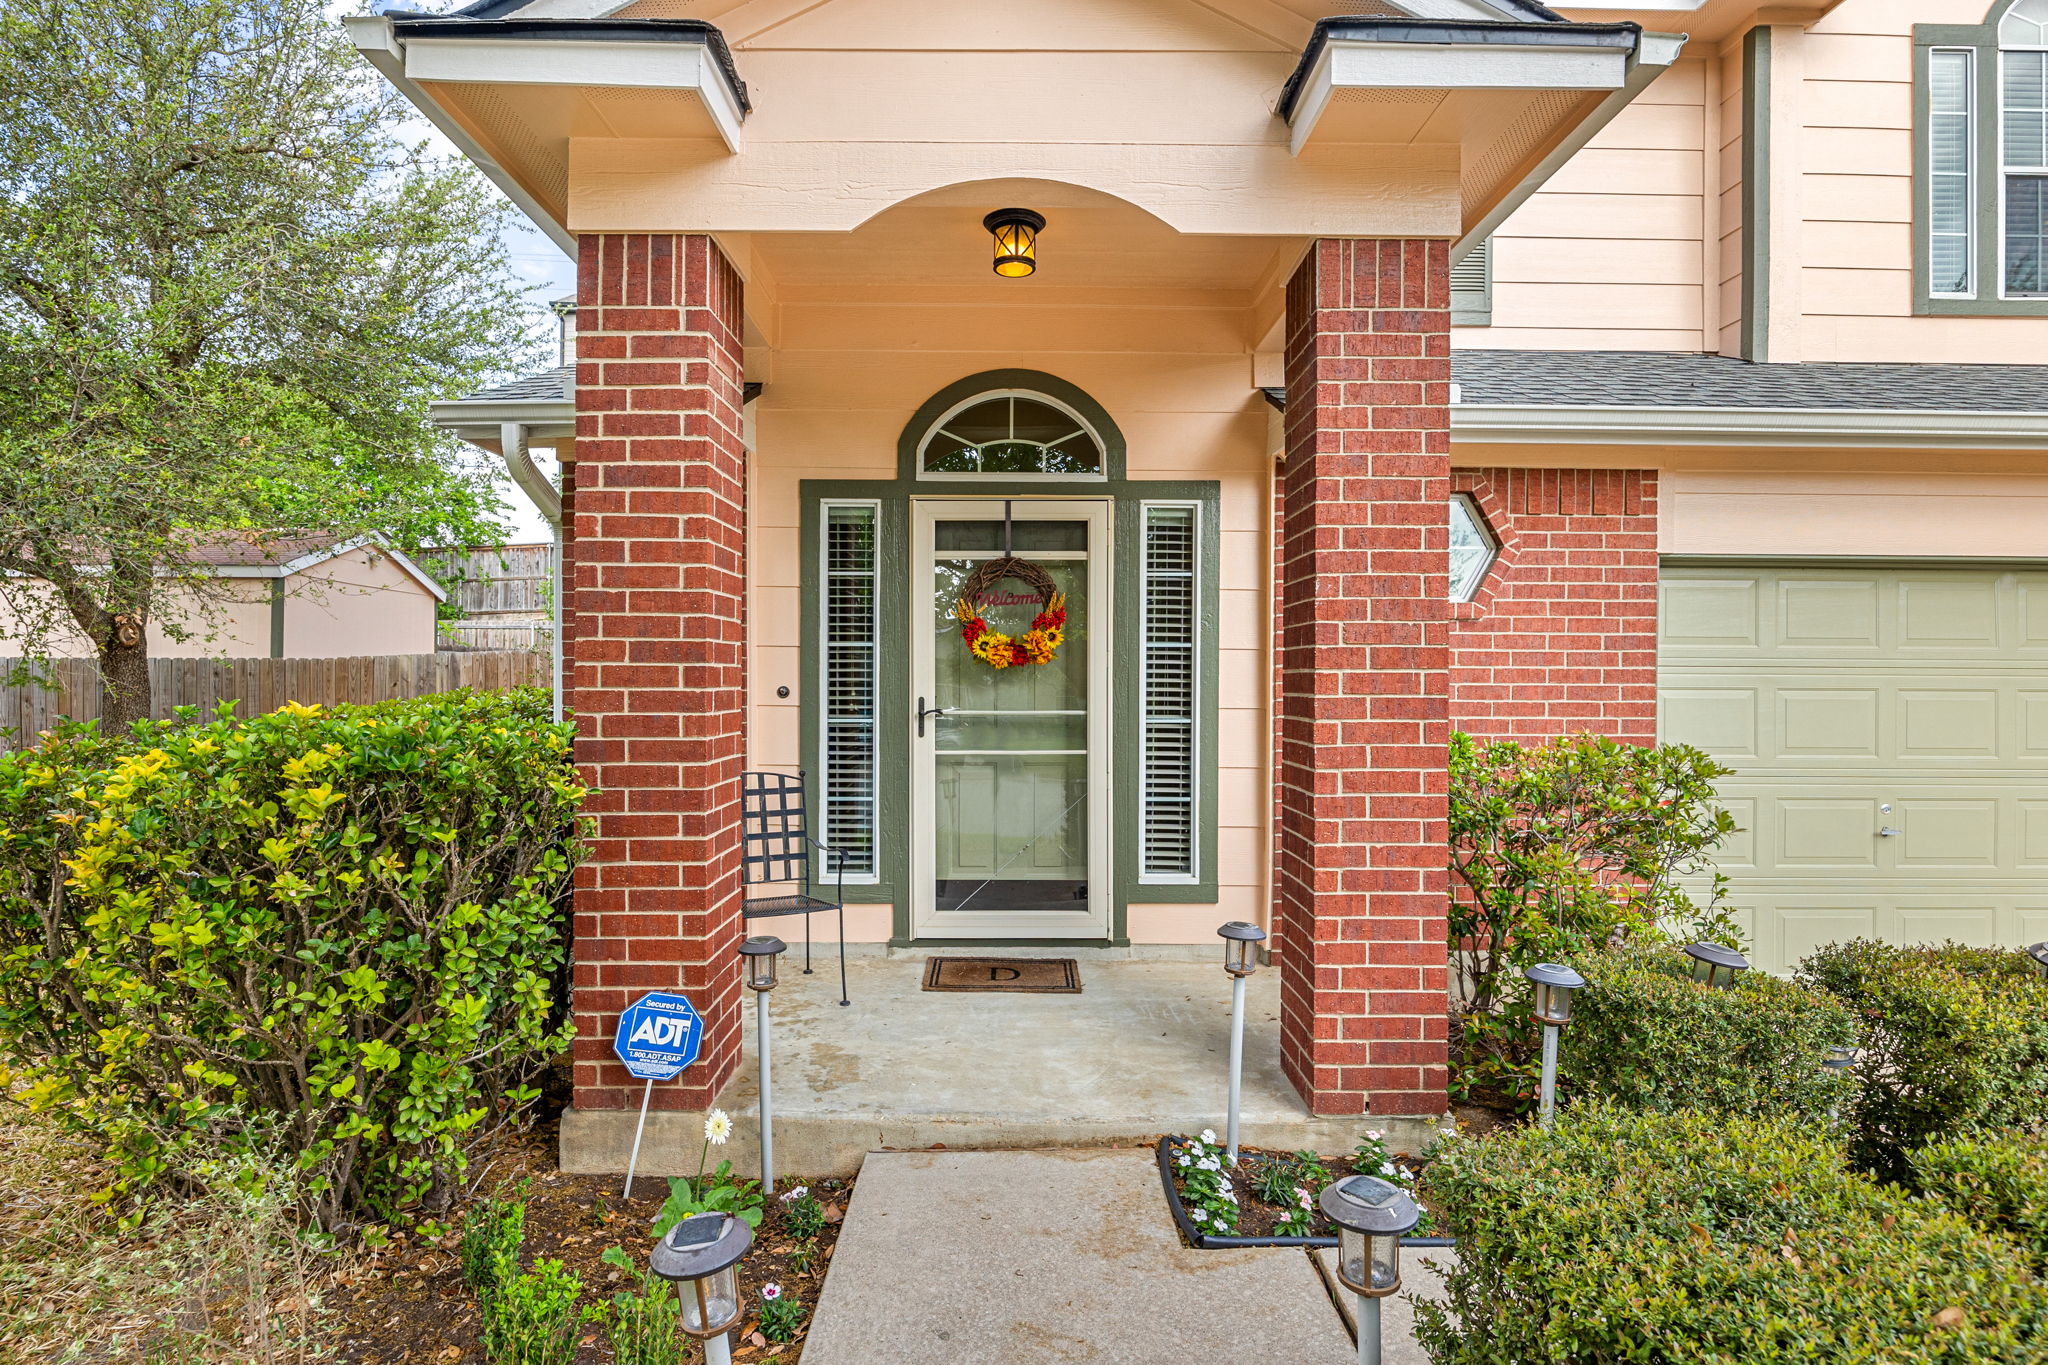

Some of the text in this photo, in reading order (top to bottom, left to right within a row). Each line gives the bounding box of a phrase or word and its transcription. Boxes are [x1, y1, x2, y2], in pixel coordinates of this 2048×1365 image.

[975, 589, 1043, 606] Welcome
[990, 967, 1021, 981] D
[646, 999, 686, 1012] Secured by
[630, 1016, 690, 1047] ADT
